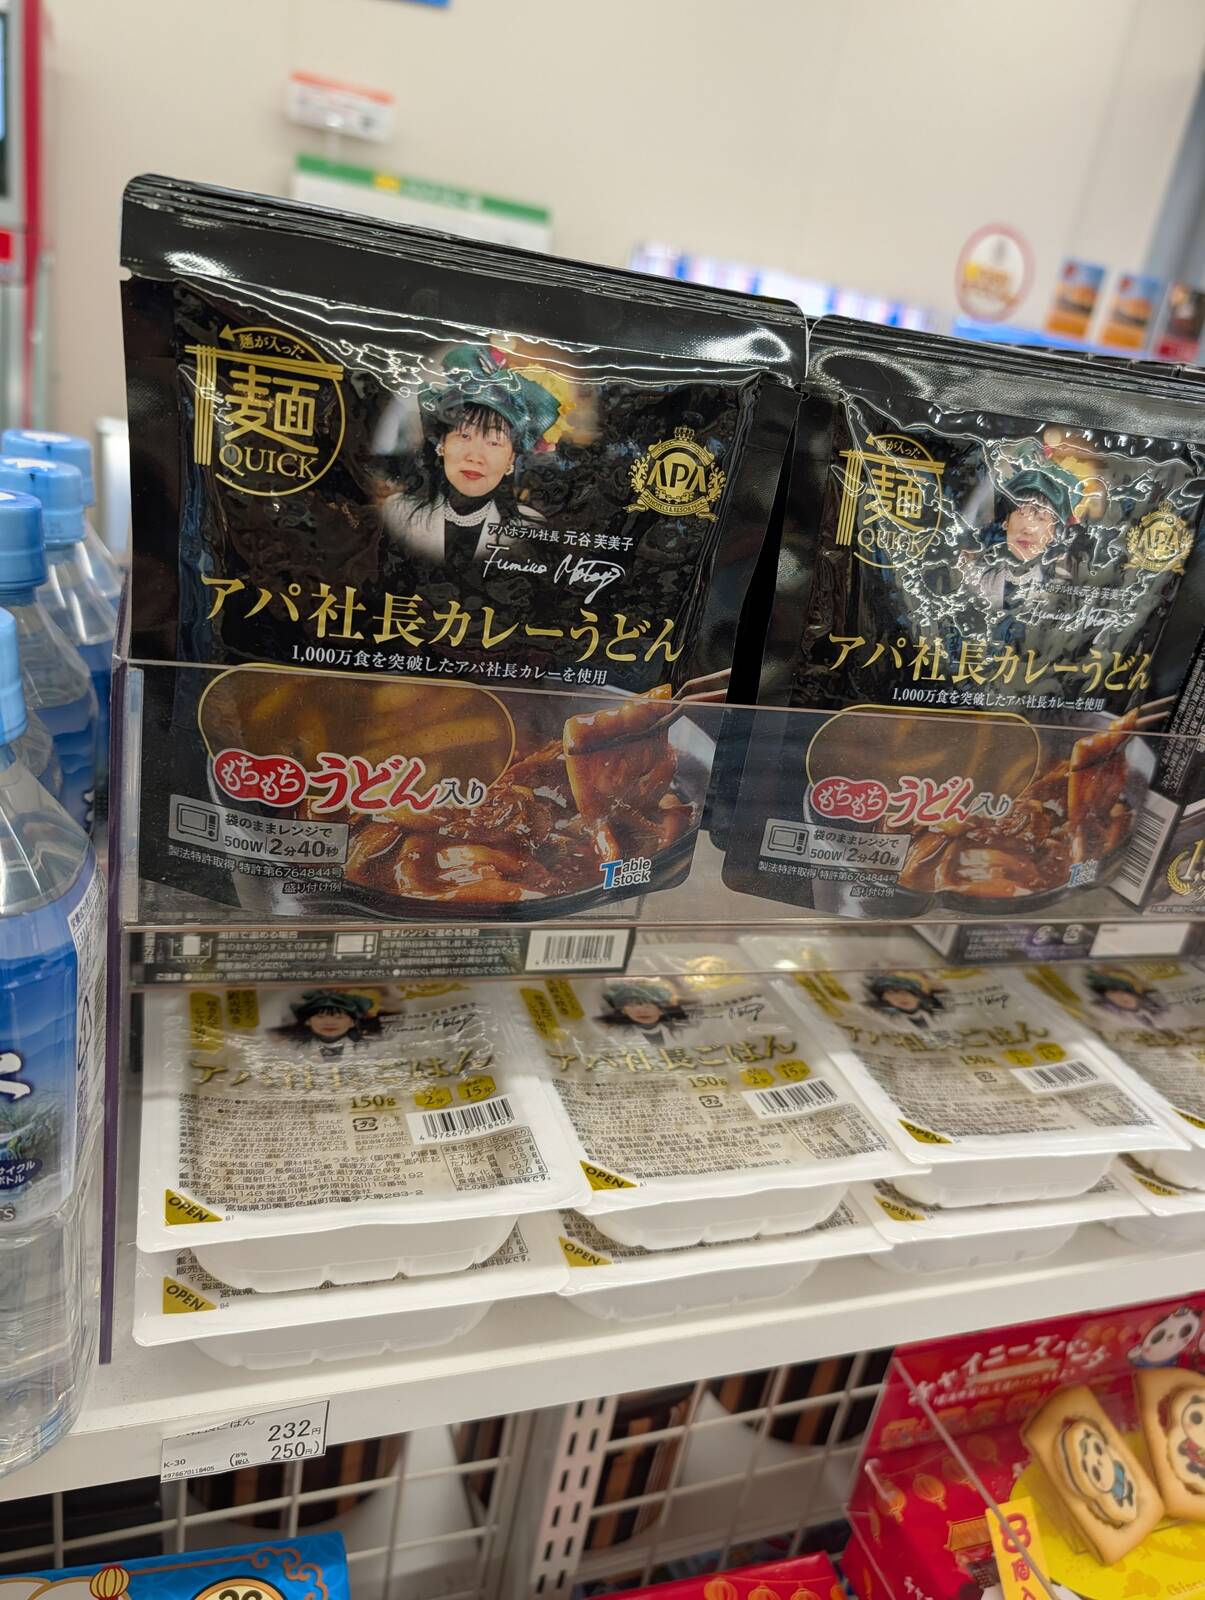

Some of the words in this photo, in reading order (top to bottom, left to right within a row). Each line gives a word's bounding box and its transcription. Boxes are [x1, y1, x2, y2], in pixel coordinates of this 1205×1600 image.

[219, 443, 319, 480] QUICK
[646, 459, 707, 494] APA
[487, 523, 561, 544] アパホテル社長
[562, 530, 592, 548] 元谷
[594, 534, 634, 552] 芙美子
[200, 575, 687, 665] アパ社長カレーうどん
[290, 643, 609, 686] 1,000万食を突破したアパ社長カレーを使用
[828, 633, 1152, 694] アパ社長カレーうどん
[892, 687, 1106, 713] 1,000万食を突破したアパ社長カレーを使用
[224, 812, 333, 839] 袋のままレンジで
[223, 835, 264, 854] 500W
[269, 837, 340, 859] 2分40秒
[812, 829, 900, 848] 袋のままレンジで
[167, 845, 236, 872] 製法特許取得
[239, 861, 345, 880] 特許第6764844号
[810, 847, 842, 862] 500W
[612, 869, 652, 888] stock
[758, 860, 817, 880] 製法特許取得
[688, 1074, 728, 1090] 150g
[350, 1094, 397, 1110] 150g
[585, 1165, 625, 1189] OPEN
[167, 1196, 210, 1223] OPEN
[880, 1200, 917, 1221] OPEN
[563, 1242, 601, 1267] OPEN
[166, 1283, 207, 1313] OPEN
[267, 1418, 322, 1443] 232円
[163, 1458, 187, 1469] K-30
